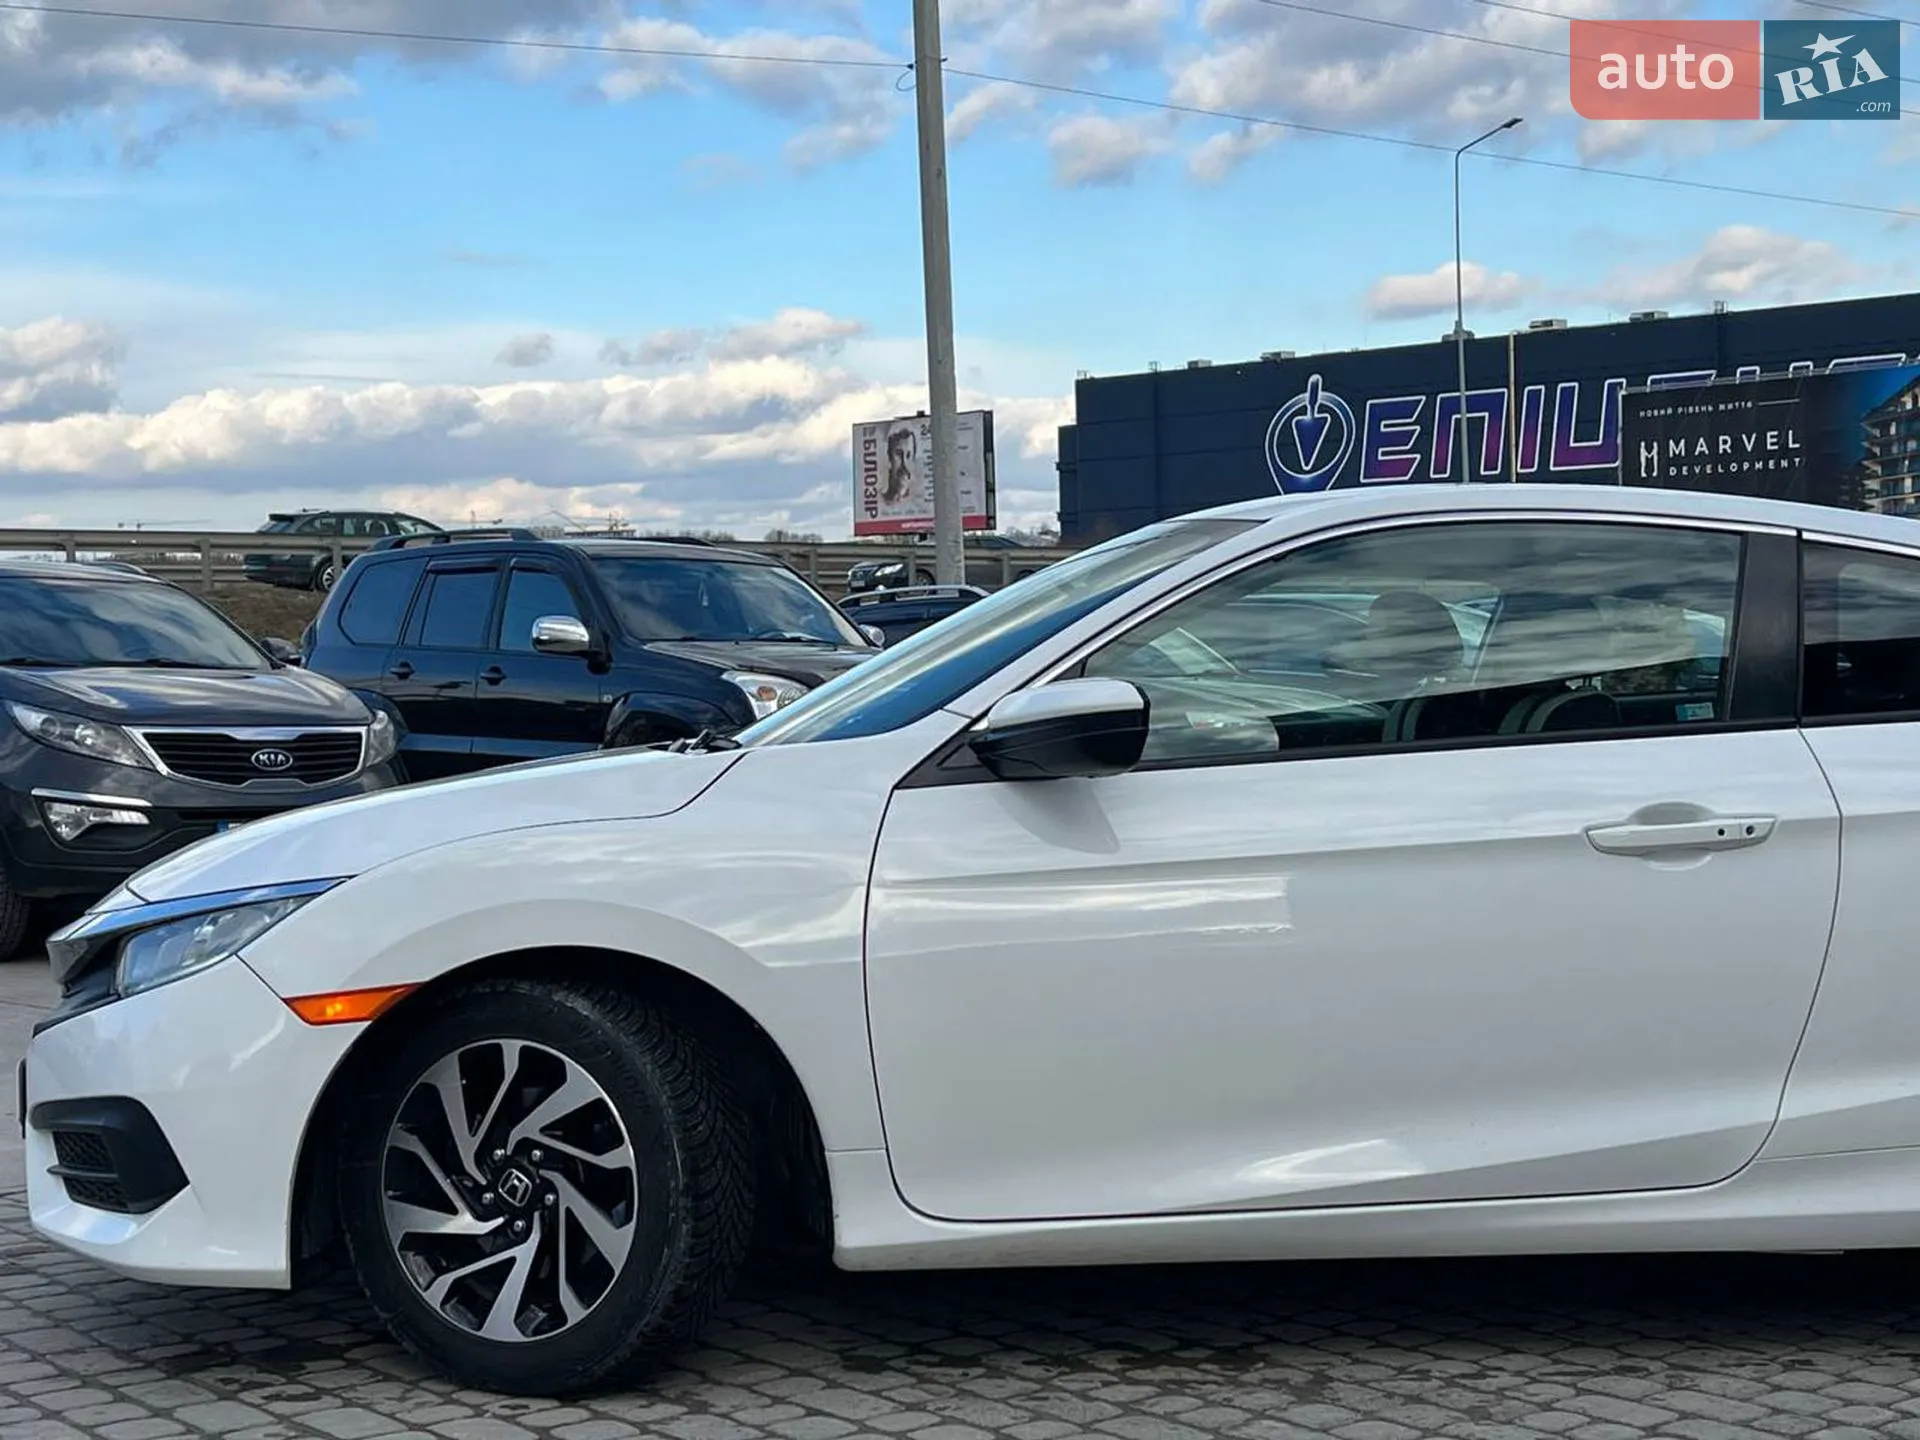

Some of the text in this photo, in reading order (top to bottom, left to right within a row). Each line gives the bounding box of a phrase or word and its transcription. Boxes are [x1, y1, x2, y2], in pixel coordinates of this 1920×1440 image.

[1669, 429, 1801, 458] MARVEL
[1669, 457, 1801, 477] DEVELOPMENT
[259, 753, 286, 766] KIA
